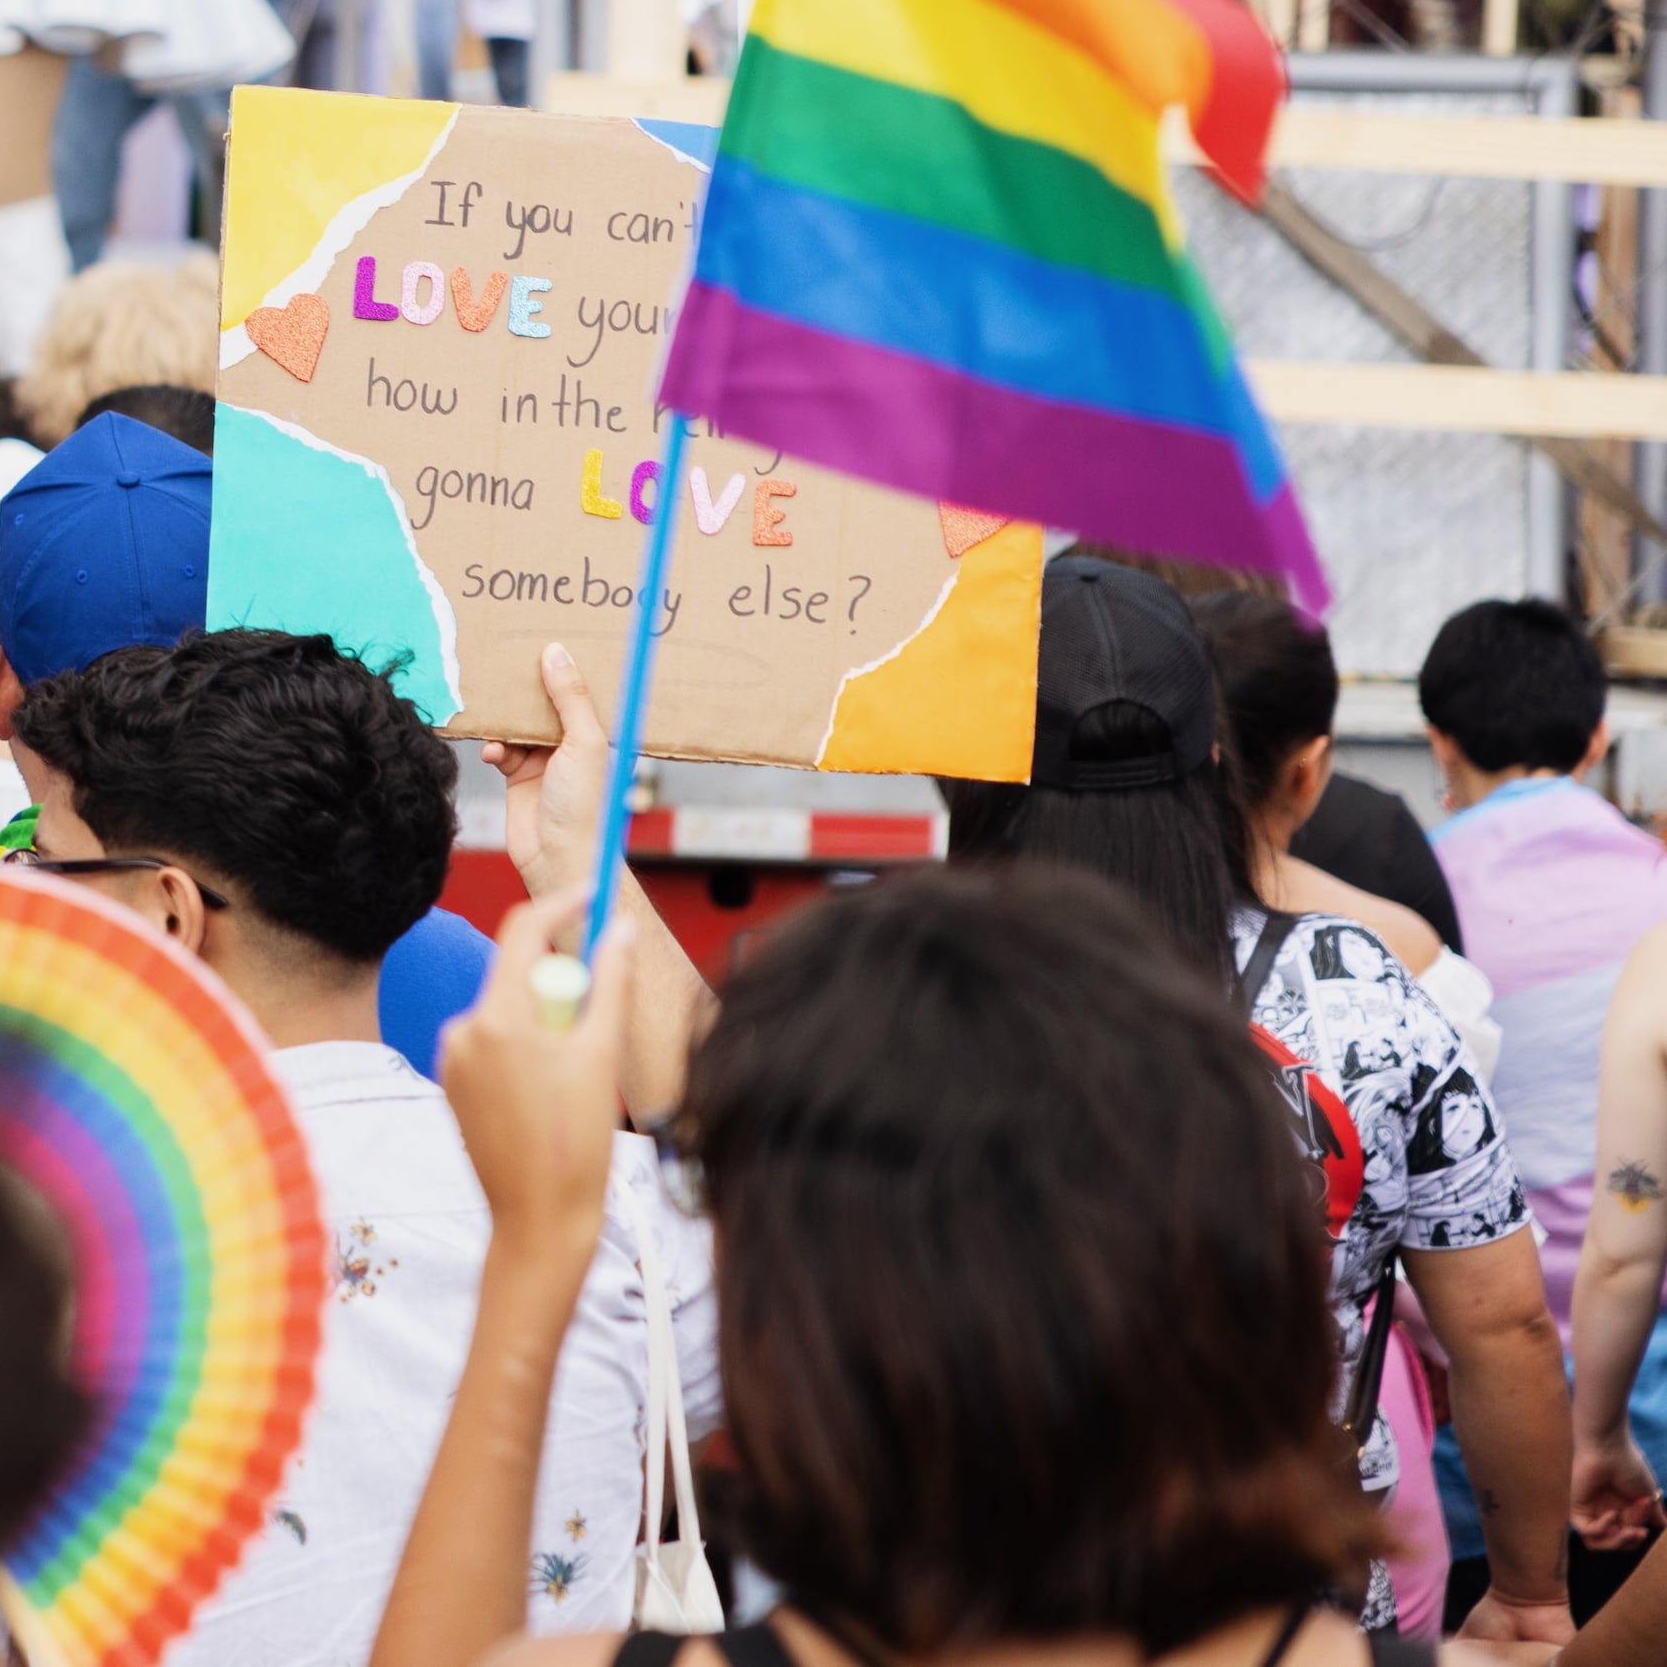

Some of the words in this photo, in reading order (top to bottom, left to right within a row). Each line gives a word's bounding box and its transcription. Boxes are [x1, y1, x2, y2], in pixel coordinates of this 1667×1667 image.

[425, 181, 482, 227] If
[504, 200, 573, 260] you
[353, 256, 553, 339] LOVE
[367, 357, 458, 415] how
[501, 387, 537, 423] in
[551, 373, 627, 432] the
[410, 466, 535, 530] gonna
[580, 448, 797, 546] LOVE
[462, 557, 682, 637] someboy
[728, 564, 872, 635] else?
